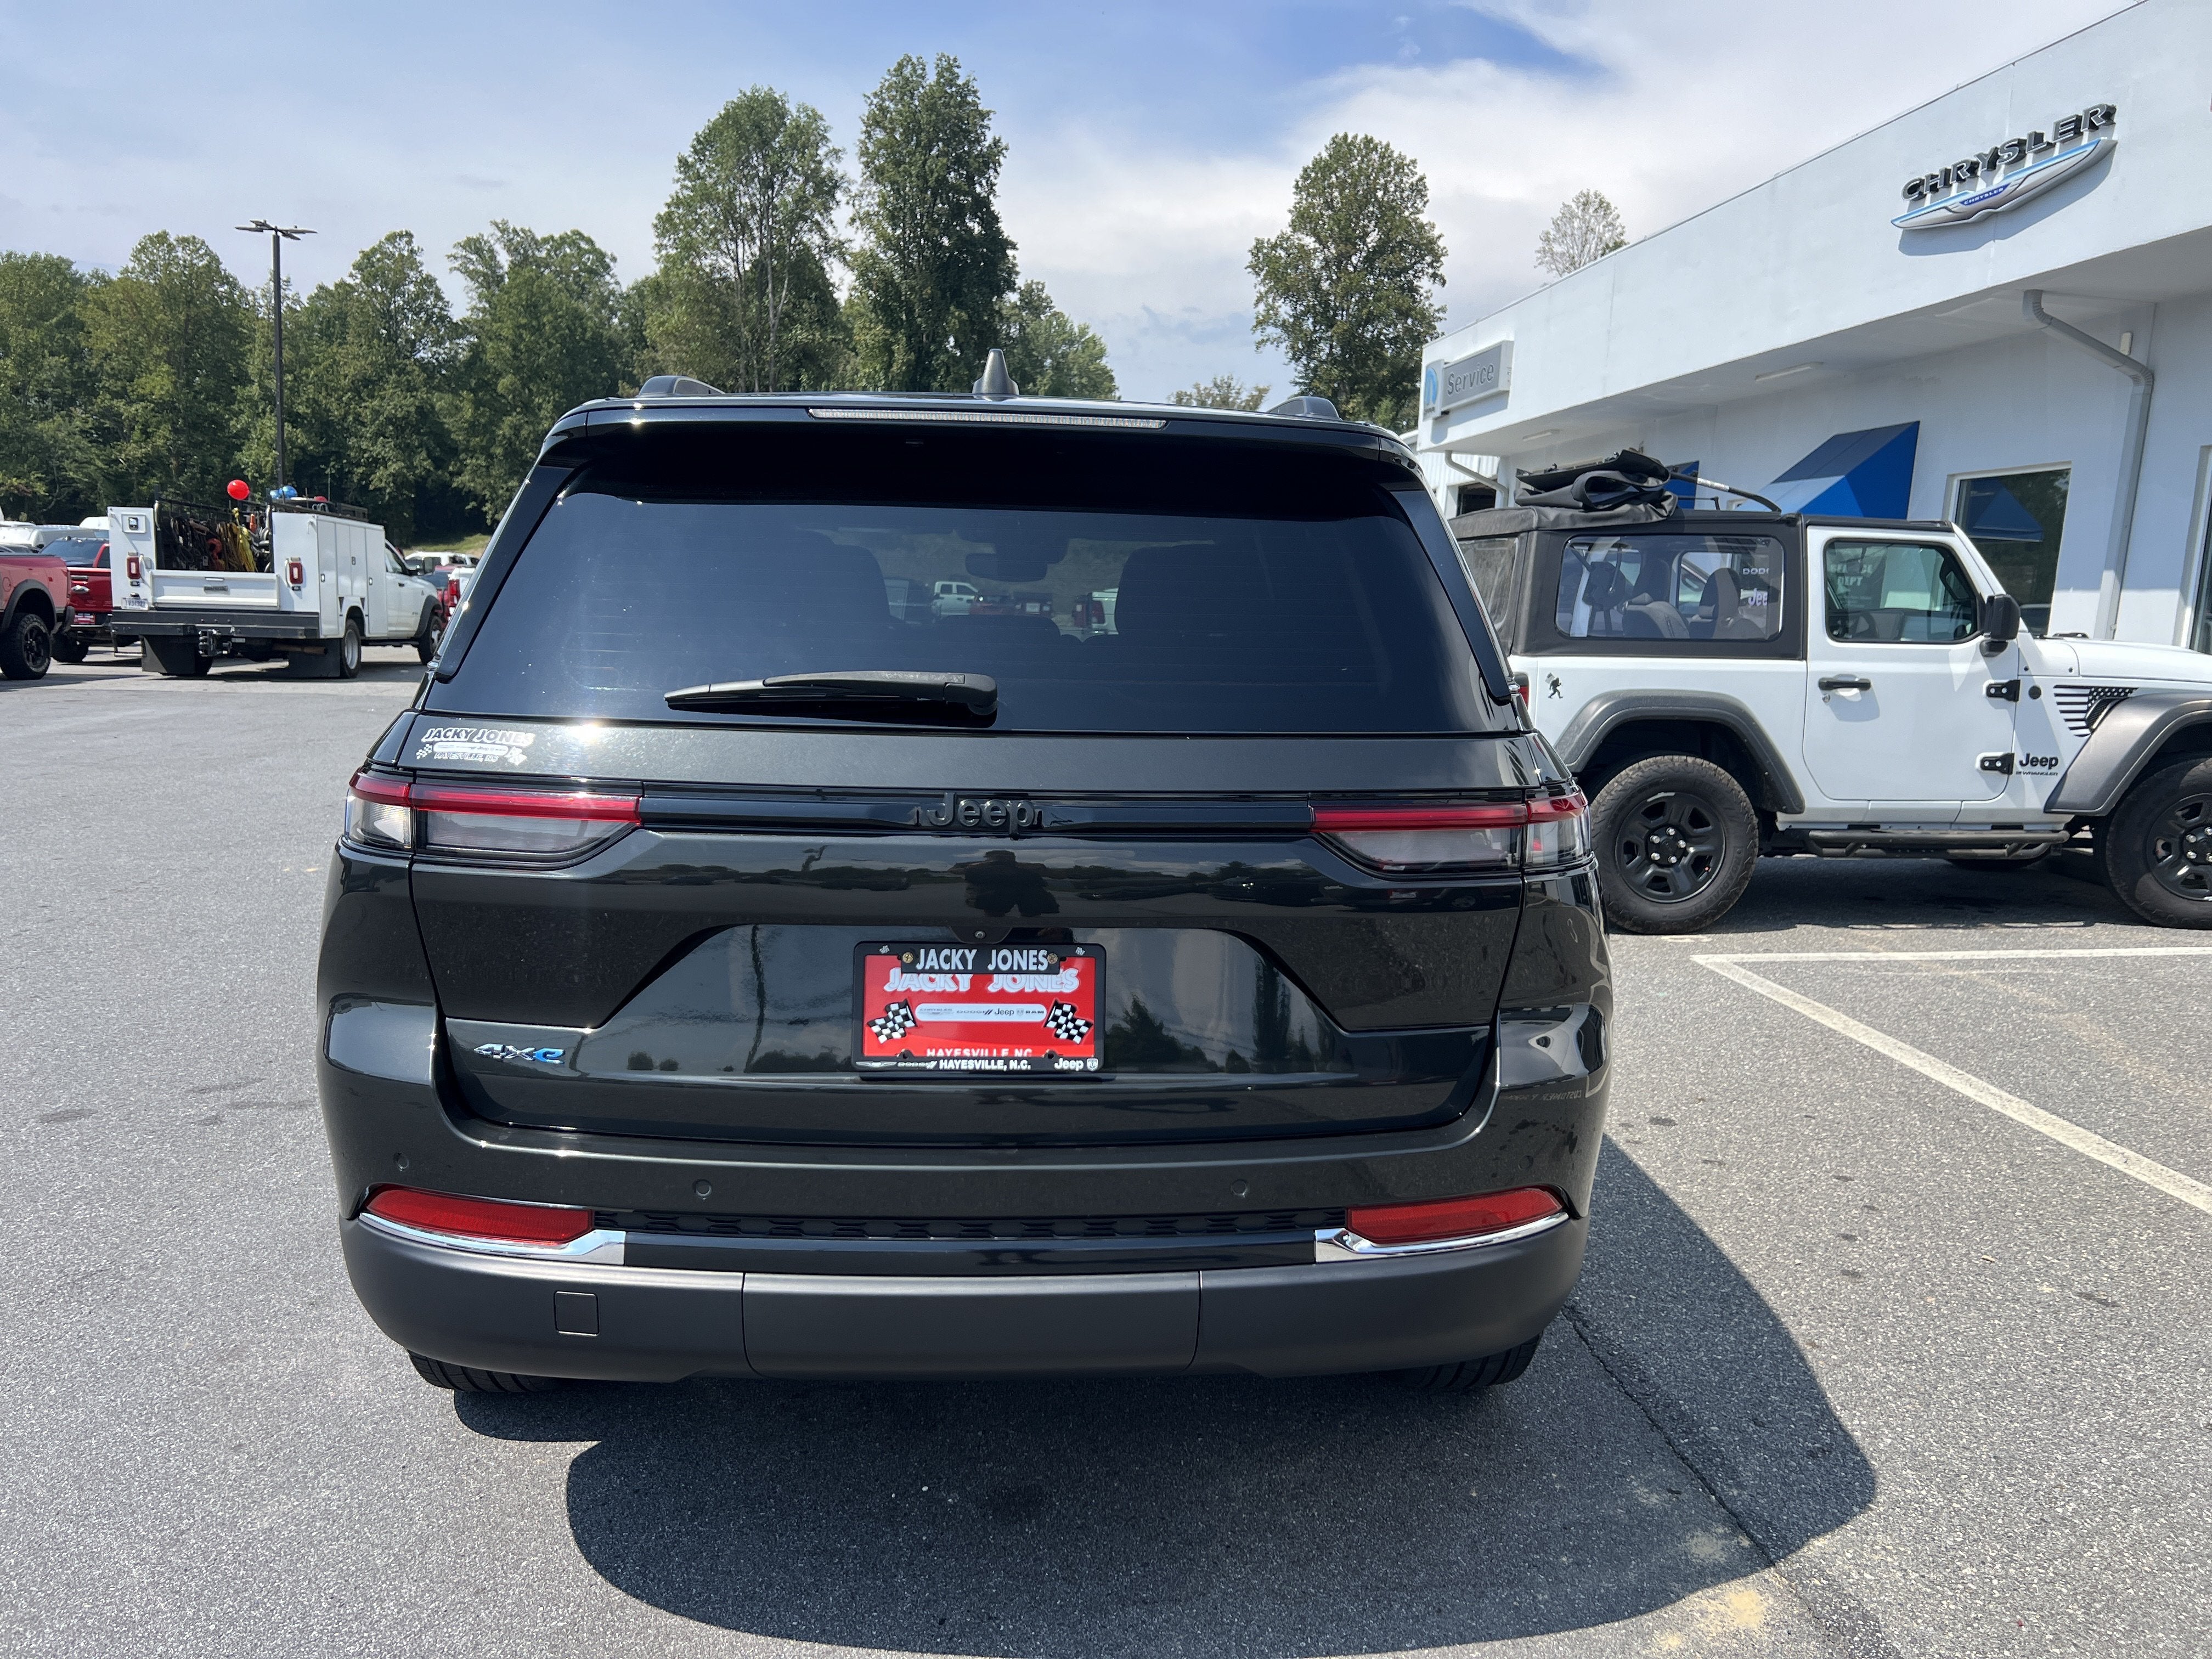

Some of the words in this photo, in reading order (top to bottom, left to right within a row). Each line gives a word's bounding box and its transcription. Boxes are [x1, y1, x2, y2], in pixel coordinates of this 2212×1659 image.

[1901, 103, 2117, 201] CHRYSLER
[1964, 187, 2004, 205] CHRYSLER
[1447, 362, 1494, 397] Service
[421, 727, 477, 742] JACKY
[473, 729, 535, 747] JONES
[2019, 753, 2058, 770] Jeep
[927, 792, 1035, 835] Jeep
[916, 949, 977, 970] JACKY
[988, 949, 1048, 970] JONES
[884, 967, 974, 992] JACKY
[988, 968, 1080, 993] JONES
[995, 1008, 1014, 1016] Jeep
[939, 1059, 1007, 1071] HAYESVILLE,
[1009, 1059, 1031, 1070] N.C.
[1054, 1058, 1084, 1071] Jeep
